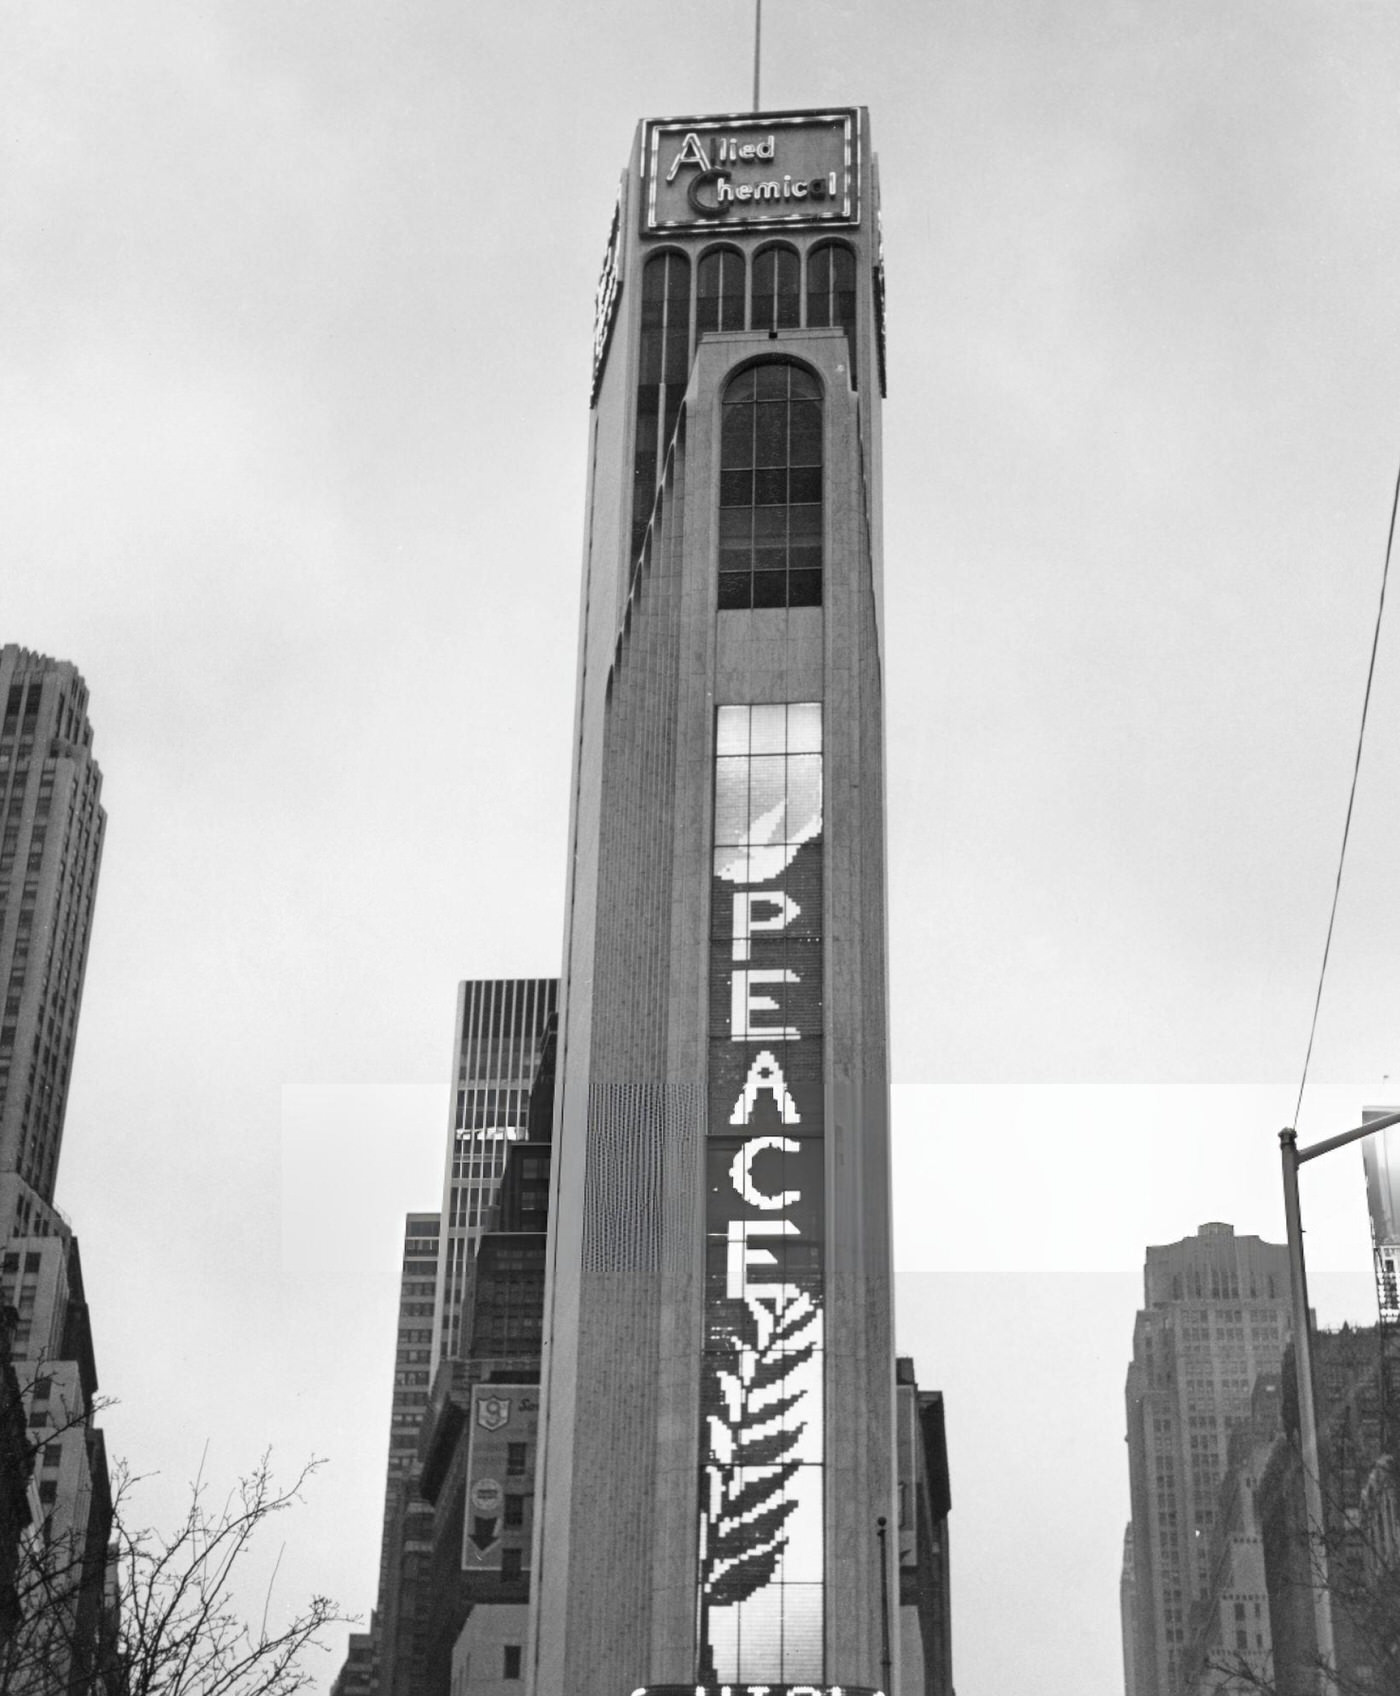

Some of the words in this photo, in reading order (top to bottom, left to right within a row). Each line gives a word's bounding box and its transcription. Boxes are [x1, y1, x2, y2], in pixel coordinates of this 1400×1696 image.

[666, 133, 775, 181] Allied
[687, 167, 838, 217] Chemical
[726, 891, 801, 1299] PEACE
